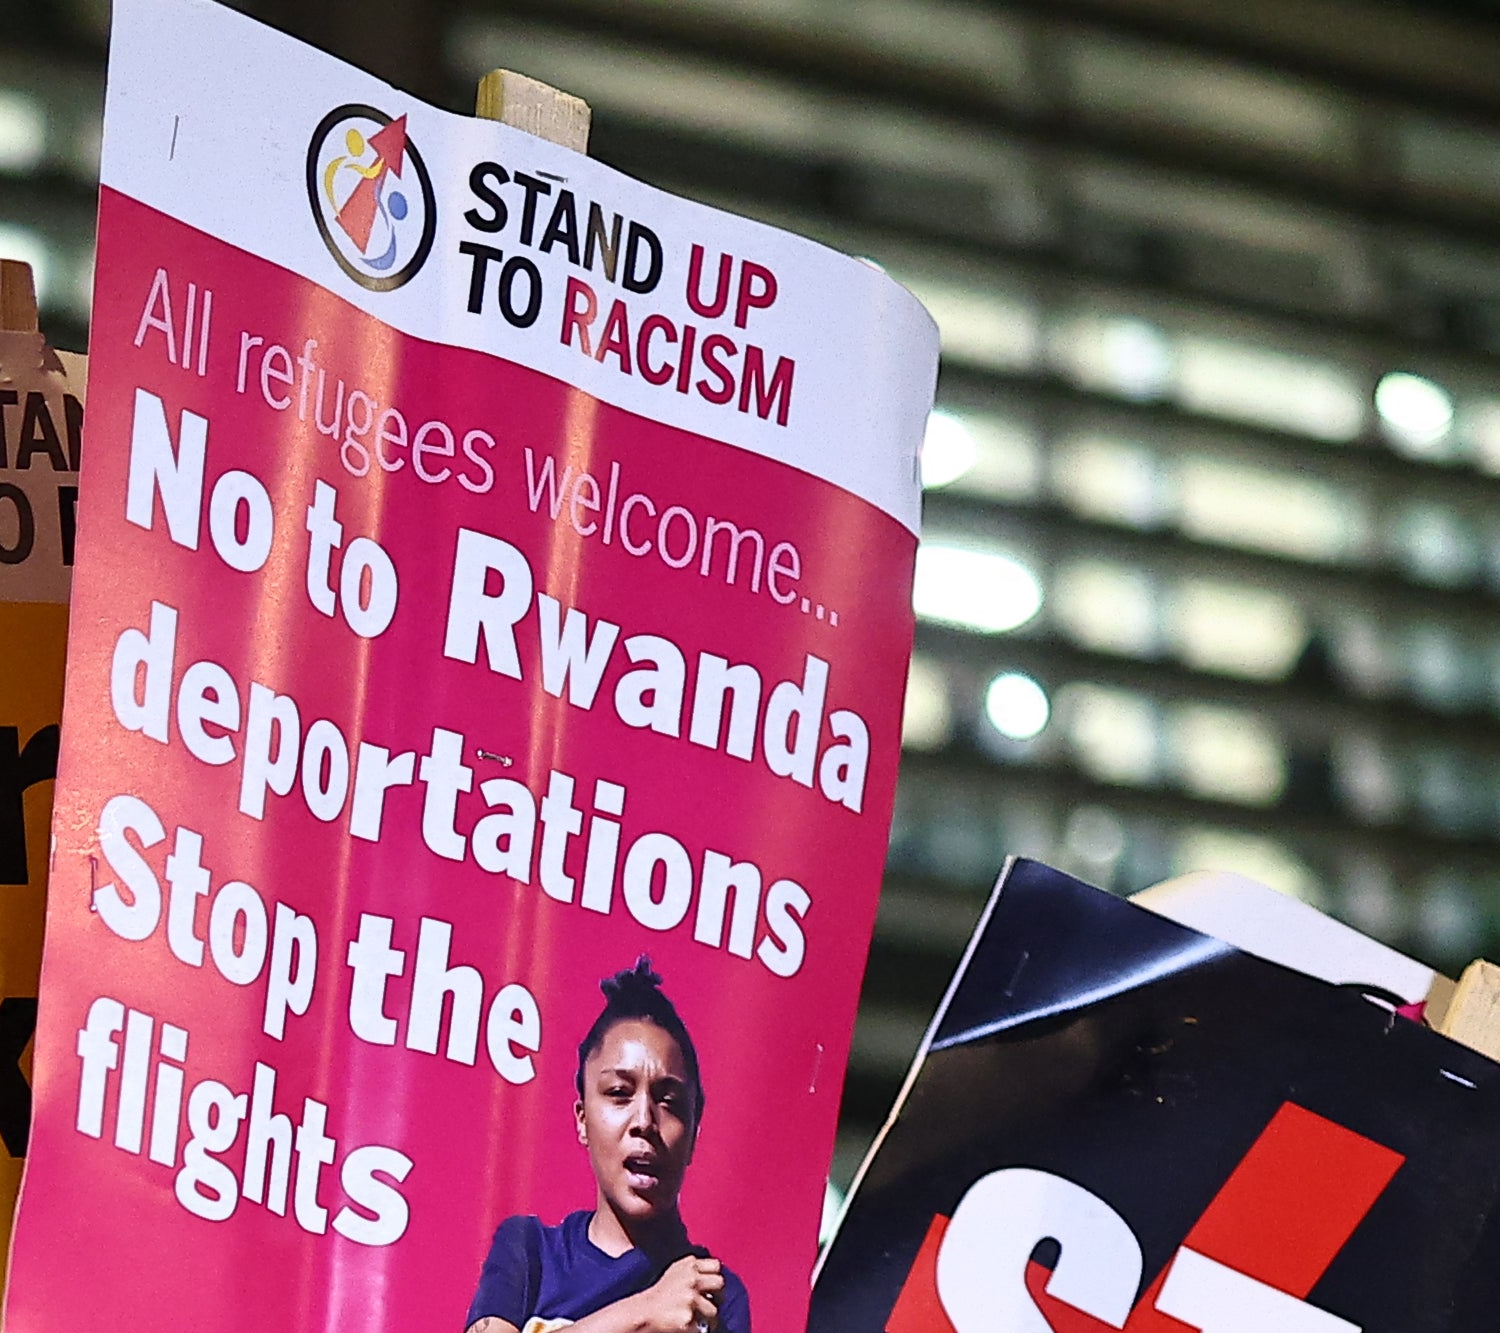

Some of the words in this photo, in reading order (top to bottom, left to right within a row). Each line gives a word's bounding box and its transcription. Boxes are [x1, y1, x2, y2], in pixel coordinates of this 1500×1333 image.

[459, 241, 542, 328] TO
[562, 280, 795, 427] RACISM
[463, 162, 664, 295] STAND
[685, 244, 778, 328] UP
[134, 267, 212, 377] All
[236, 328, 497, 494] refugees
[523, 447, 840, 628] welcome...
[125, 387, 274, 575] No
[305, 479, 398, 639] to
[443, 527, 869, 814] Rwanda
[109, 601, 813, 979] deportations
[91, 794, 318, 1039] Stop
[347, 914, 541, 1085] the
[76, 996, 414, 1248] flights
